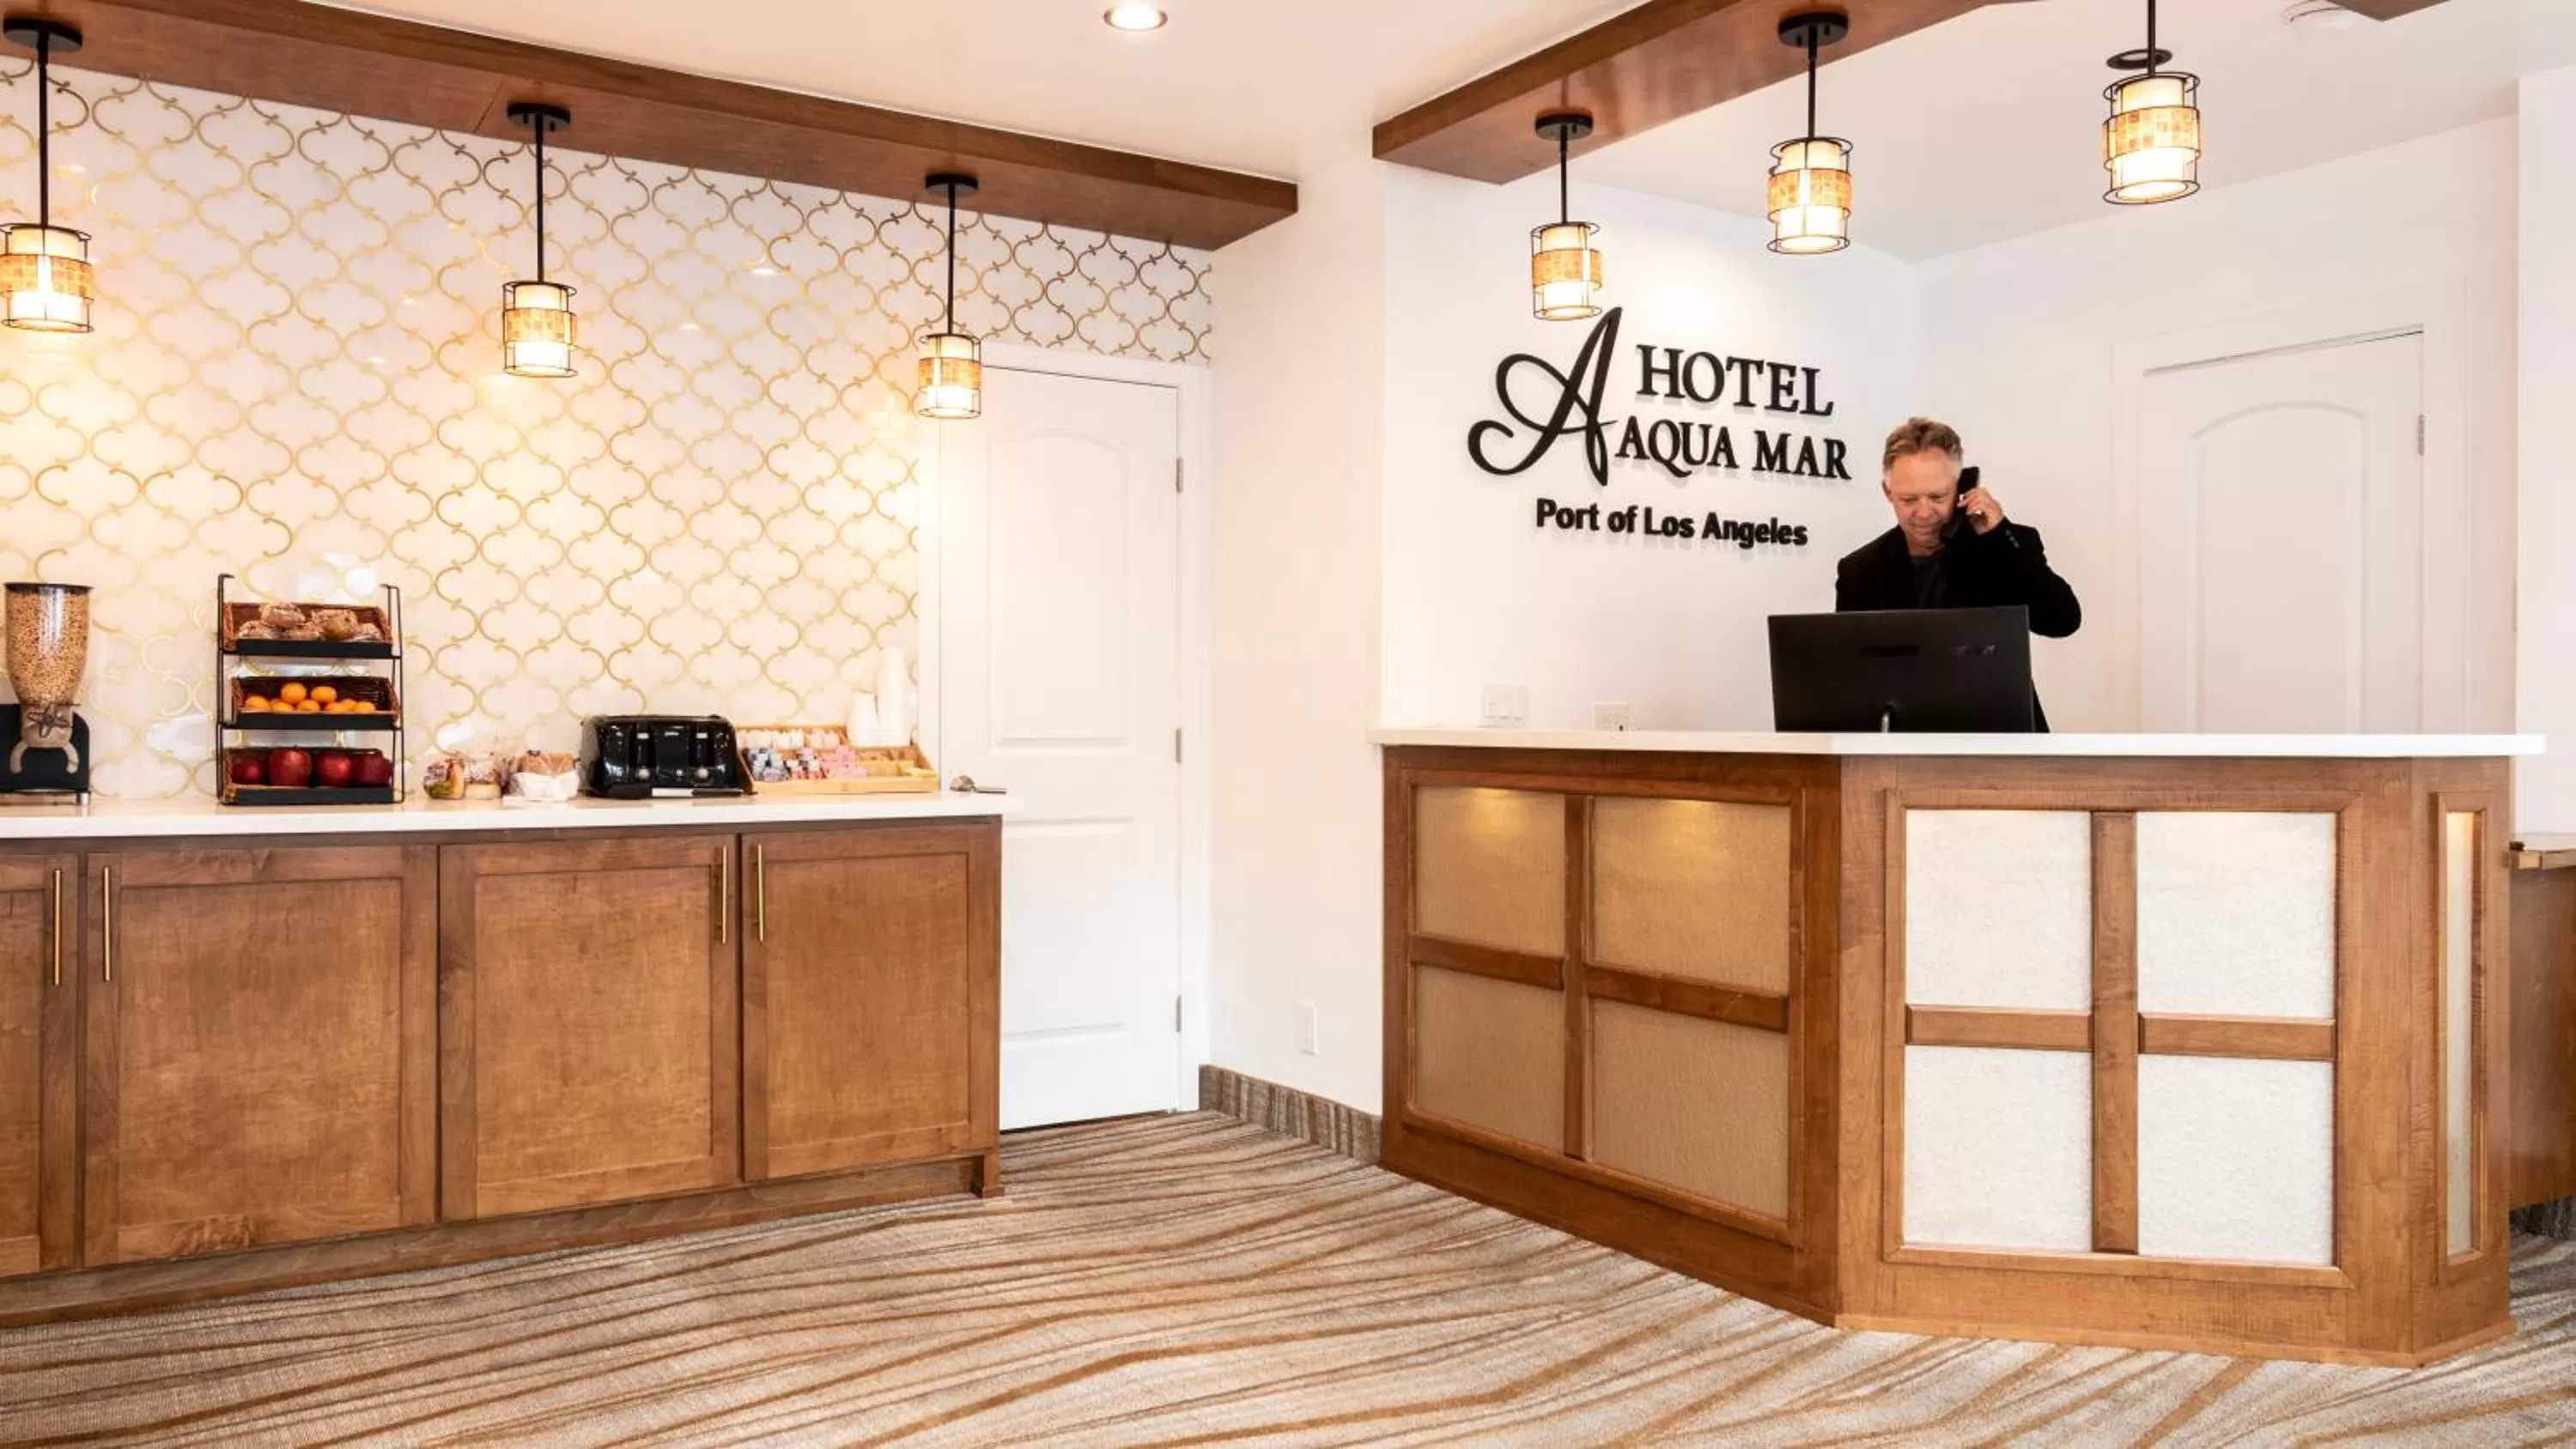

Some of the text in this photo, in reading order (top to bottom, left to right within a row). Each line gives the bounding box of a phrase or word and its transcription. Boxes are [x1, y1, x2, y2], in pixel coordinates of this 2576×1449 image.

[1636, 344, 1834, 416] HOTEL
[1614, 415, 1852, 481] AQUA MAR
[1536, 498, 1808, 550] Port of Los Angeles
